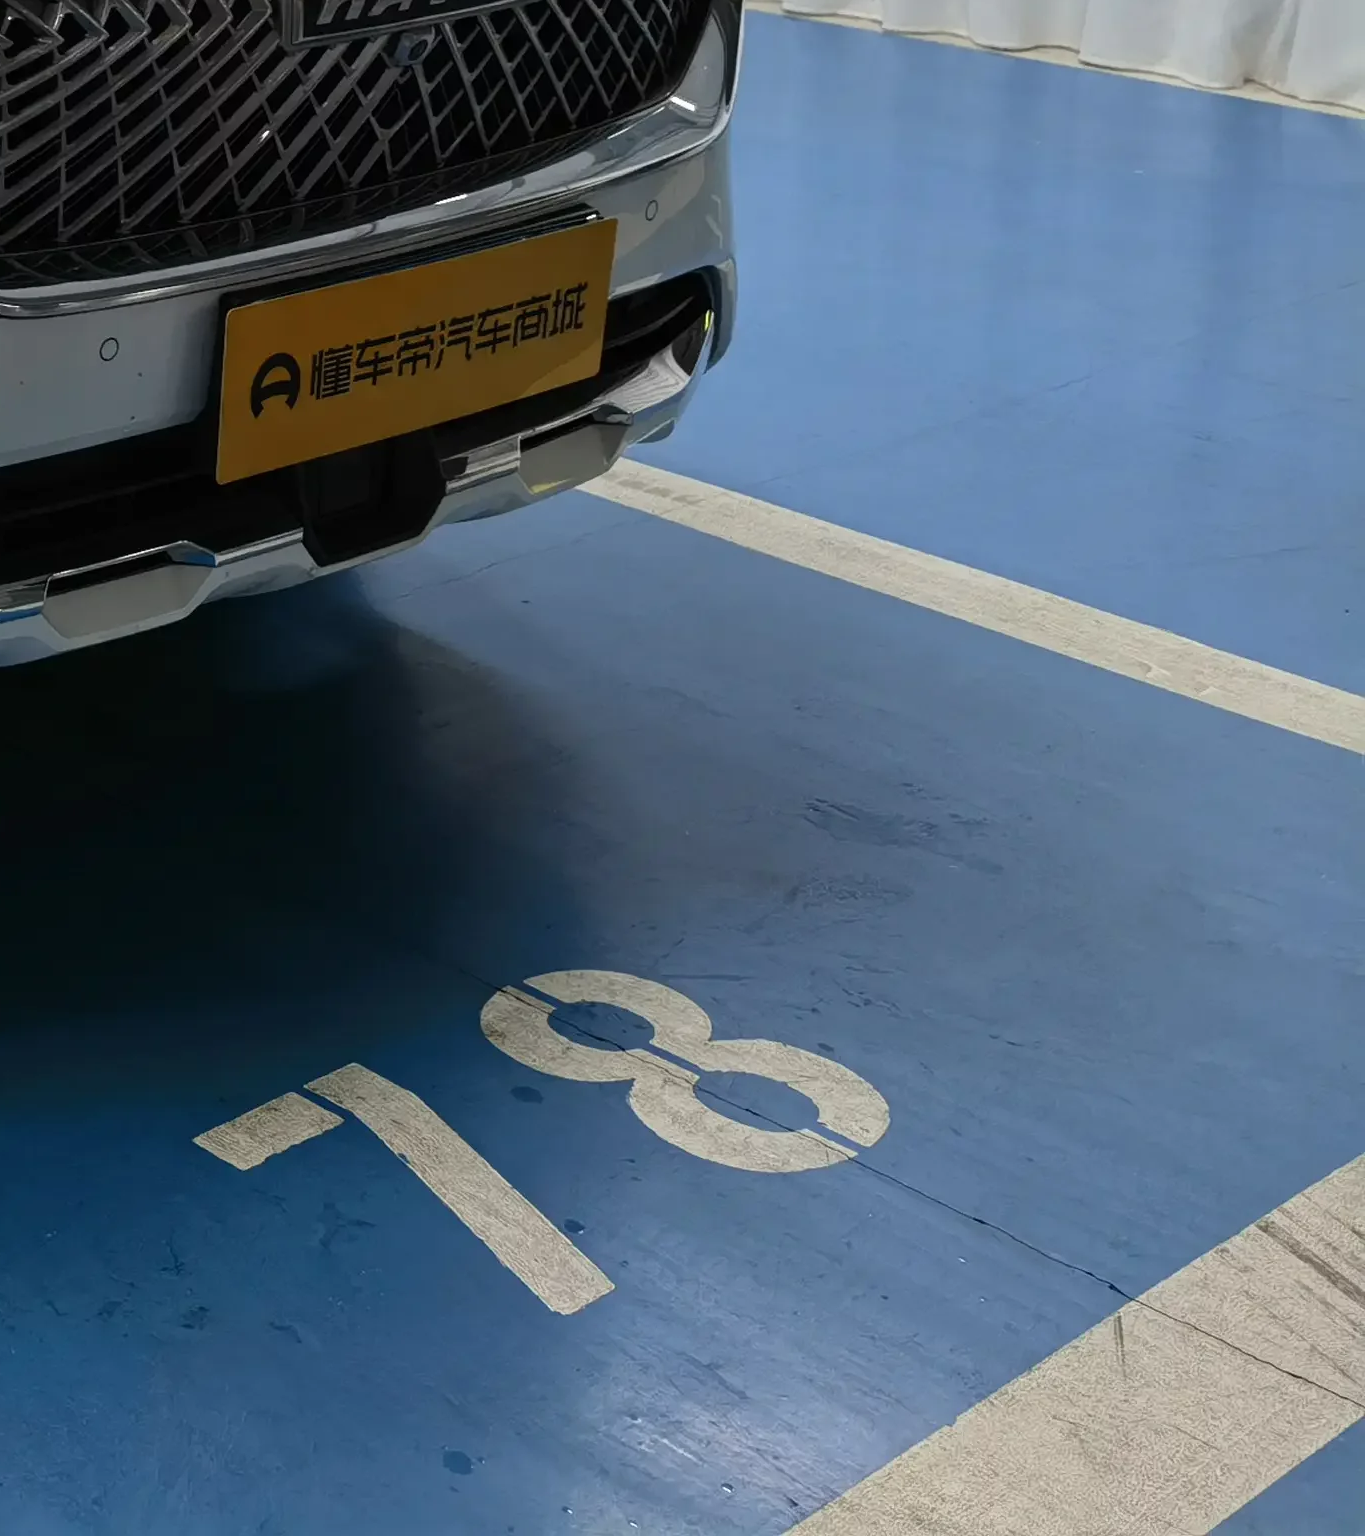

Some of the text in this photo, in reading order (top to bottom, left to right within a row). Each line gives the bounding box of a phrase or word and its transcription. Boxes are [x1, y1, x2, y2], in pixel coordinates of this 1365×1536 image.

[309, 282, 588, 400] 懂车帝汽车商城
[192, 969, 891, 1315] 78
